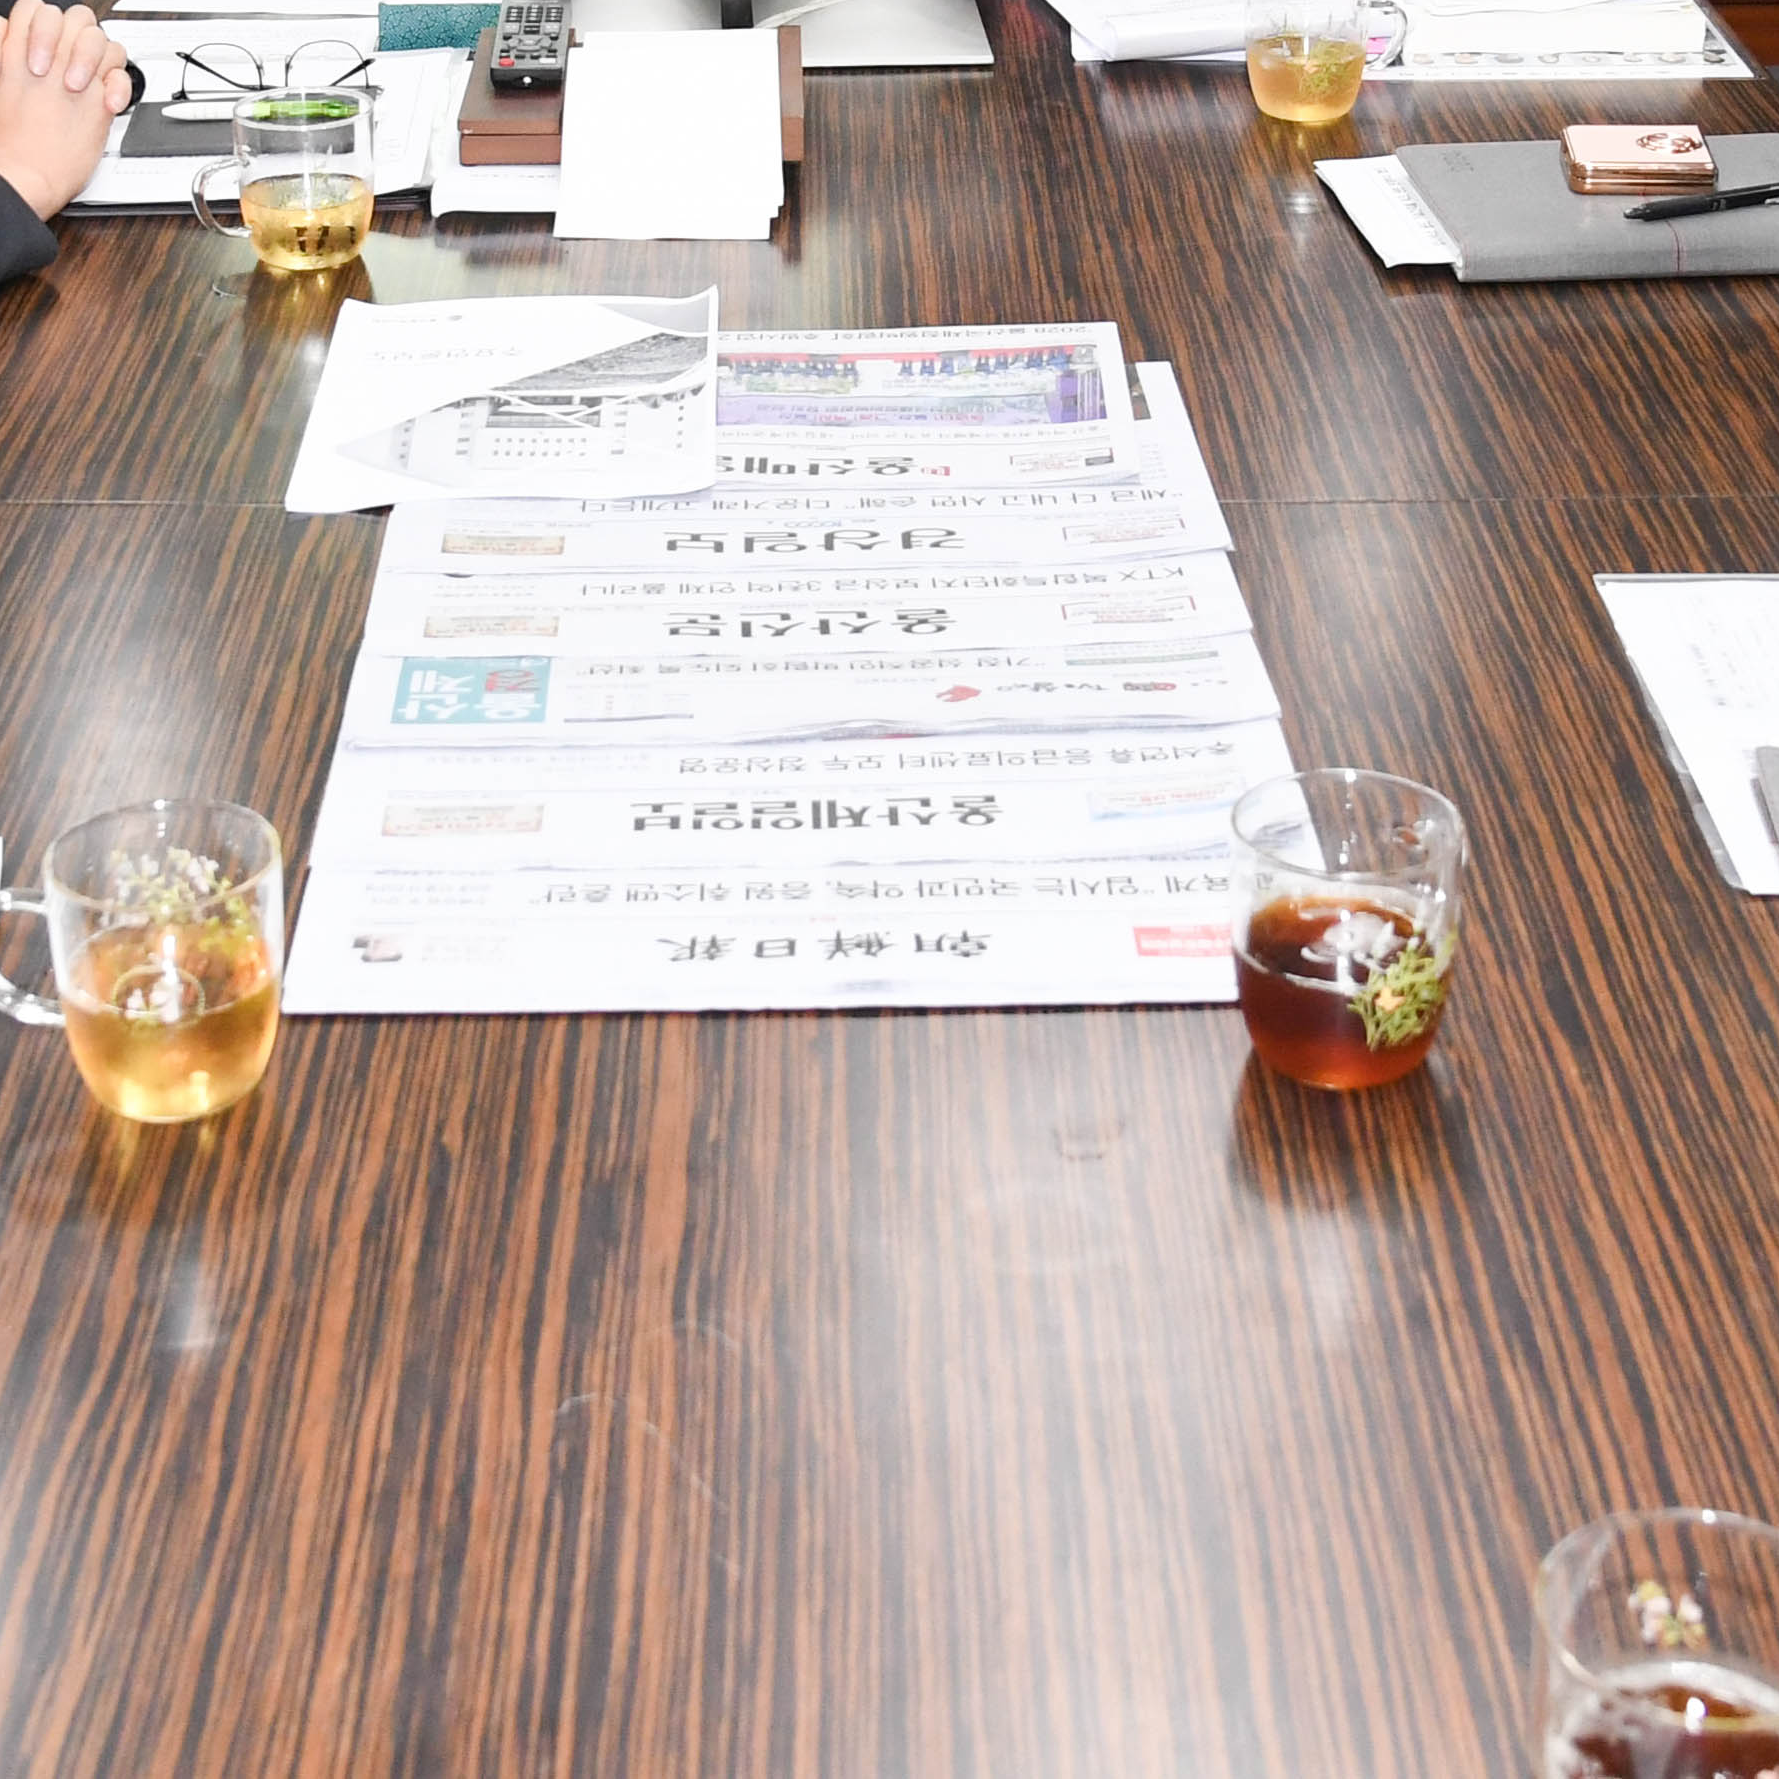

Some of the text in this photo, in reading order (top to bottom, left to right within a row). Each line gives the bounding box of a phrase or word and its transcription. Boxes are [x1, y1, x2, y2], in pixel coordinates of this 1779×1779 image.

[663, 527, 965, 553] 경상일보
[1120, 567, 1184, 581] KTX
[661, 608, 957, 637] 울산신문
[398, 693, 543, 720] 울산
[678, 742, 1234, 775] 추석연휴 응급의료센터 모두 정상운영
[629, 795, 1003, 831] 울산제일일보
[918, 877, 1020, 899] 국민과
[656, 929, 993, 962] 朝鮮日報
